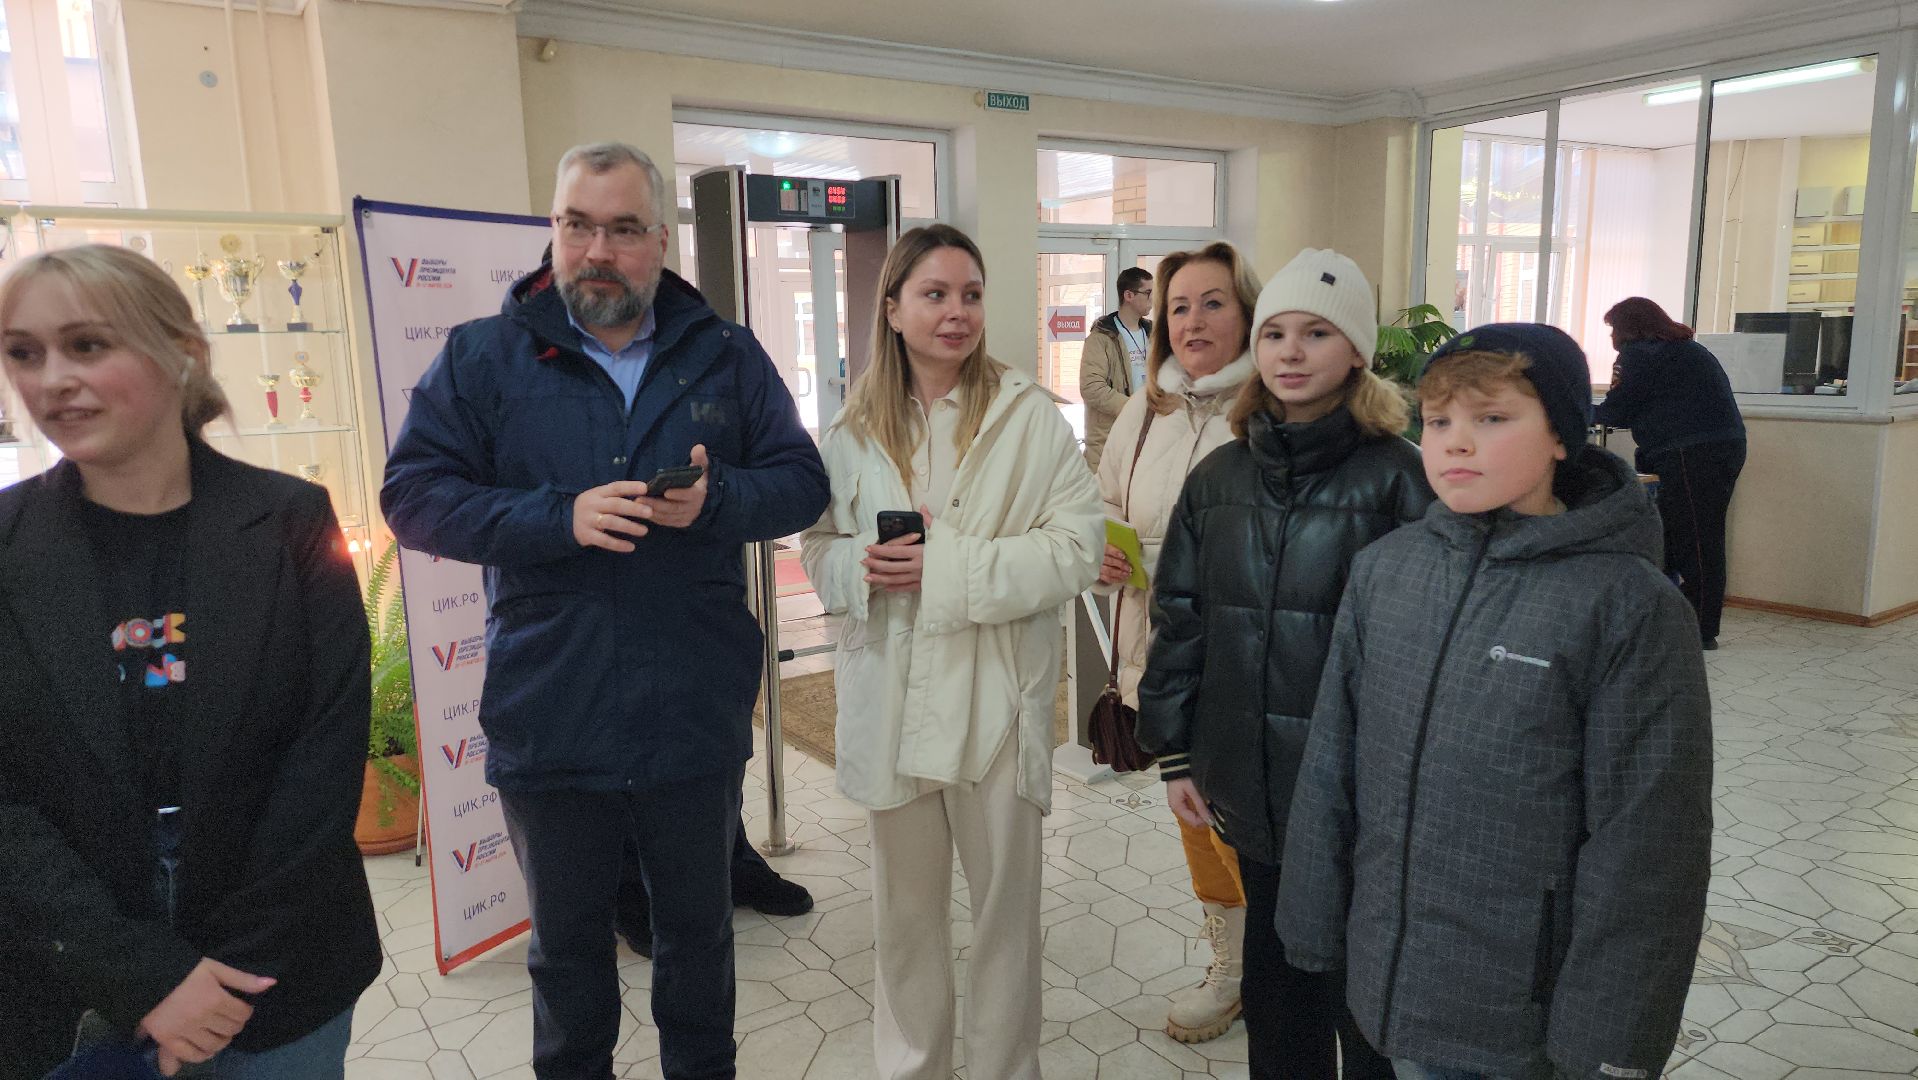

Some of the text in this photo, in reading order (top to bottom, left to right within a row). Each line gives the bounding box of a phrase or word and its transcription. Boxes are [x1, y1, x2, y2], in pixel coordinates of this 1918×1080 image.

[990, 94, 1027, 110] ВЫХОД
[1056, 320, 1081, 330] ВЫХОД
[432, 592, 479, 614] ЦИК.РФ
[443, 699, 480, 720] ЦИК.Р
[453, 791, 498, 818] ЦИК.РФ
[463, 891, 506, 920] ЦИК.РФ
